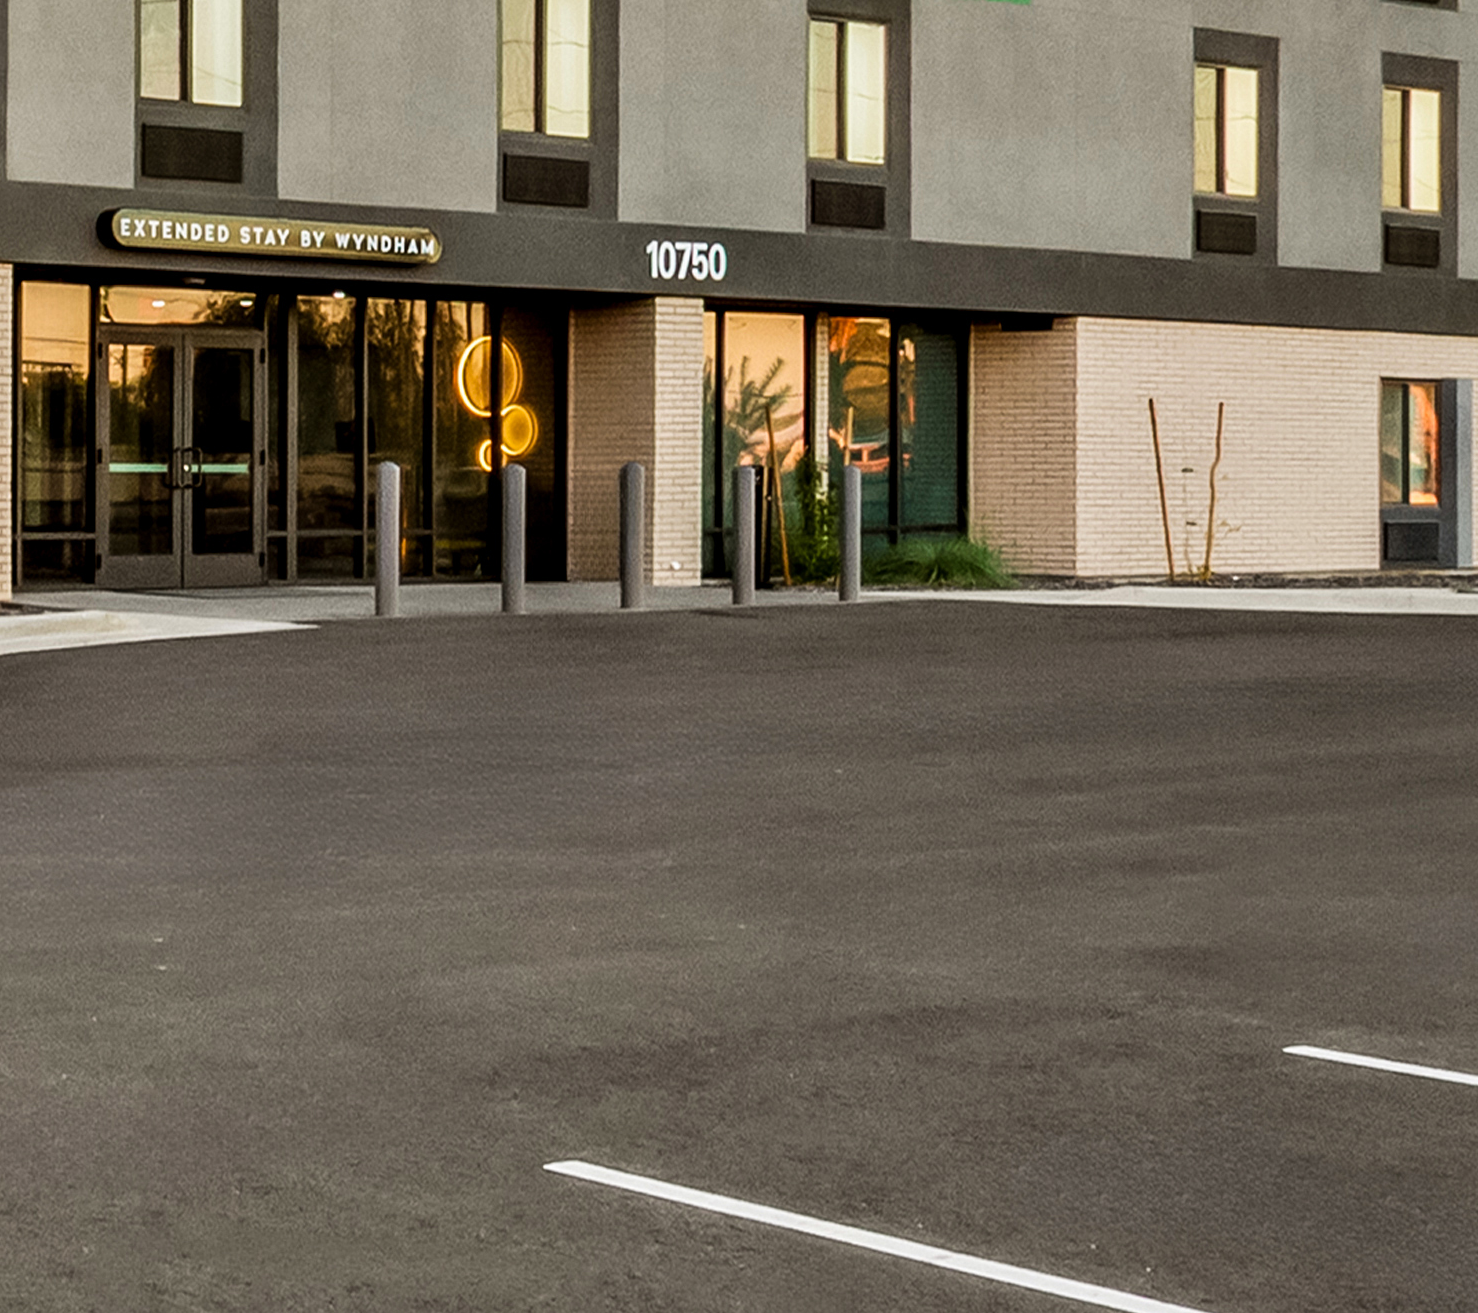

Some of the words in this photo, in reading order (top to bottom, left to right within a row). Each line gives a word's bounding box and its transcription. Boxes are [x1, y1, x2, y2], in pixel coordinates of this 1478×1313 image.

[119, 217, 230, 243] EXTENDED
[239, 225, 290, 246] STAY
[300, 229, 325, 248] BY
[334, 232, 435, 255] WYNDHAM
[645, 240, 728, 281] 10750
